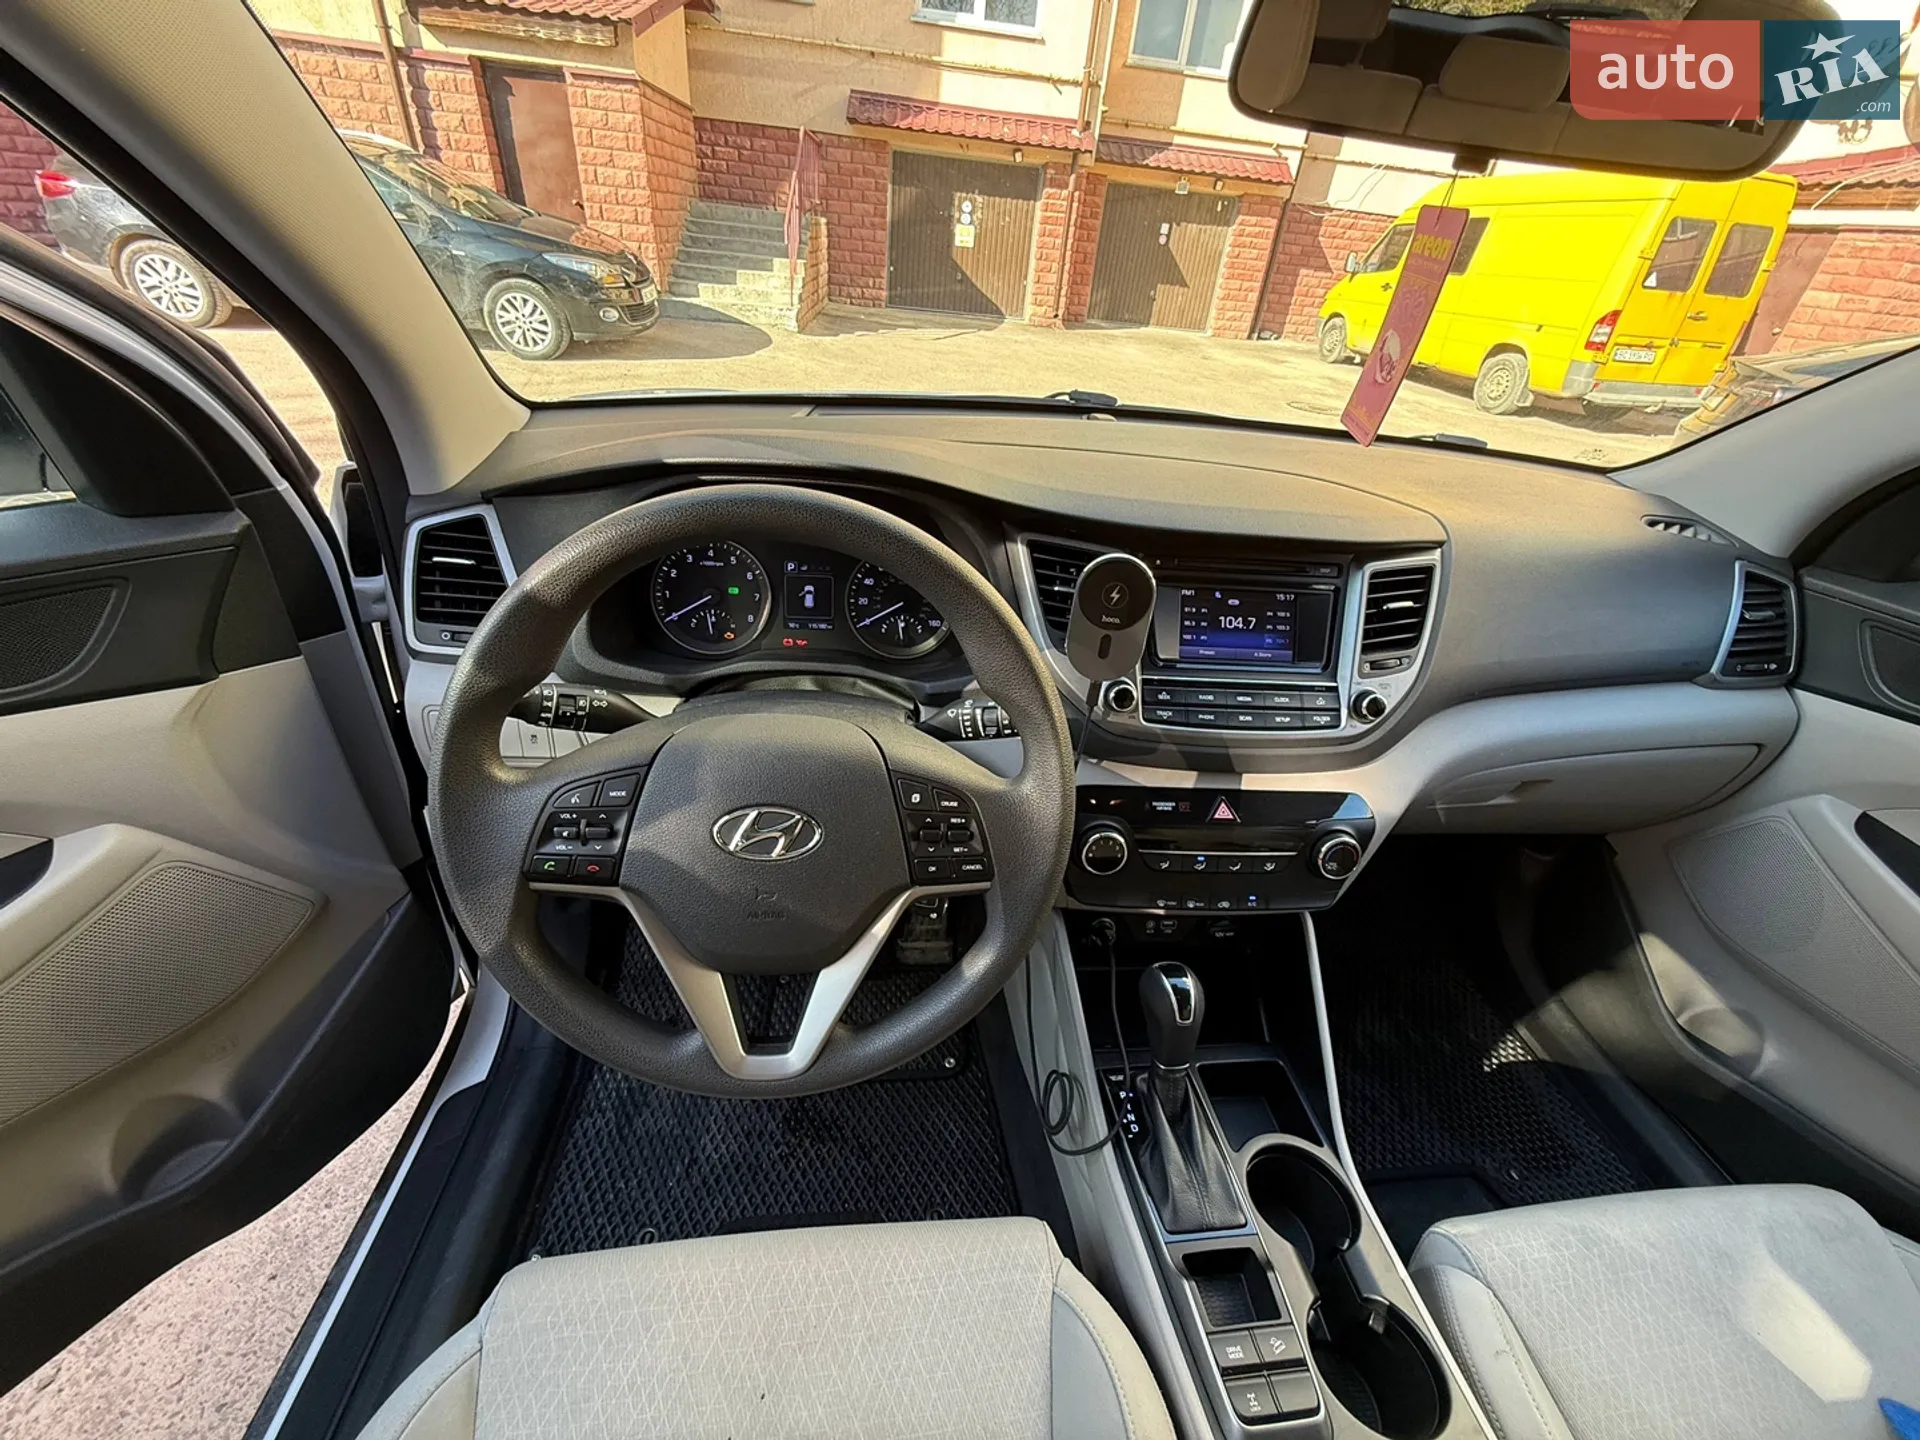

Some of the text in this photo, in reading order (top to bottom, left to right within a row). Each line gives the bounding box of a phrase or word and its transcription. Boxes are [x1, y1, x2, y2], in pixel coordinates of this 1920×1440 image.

[1411, 233, 1454, 260] areon
[686, 554, 692, 562] 3
[730, 556, 737, 564] 5
[787, 563, 795, 571] P
[670, 569, 677, 578] 2
[746, 572, 753, 580] 6
[864, 578, 874, 586] 40
[754, 593, 760, 601] 7
[748, 614, 754, 623] 8
[1219, 616, 1256, 630] 104.7
[1119, 1091, 1126, 1099] P
[1130, 1124, 1139, 1132] D
